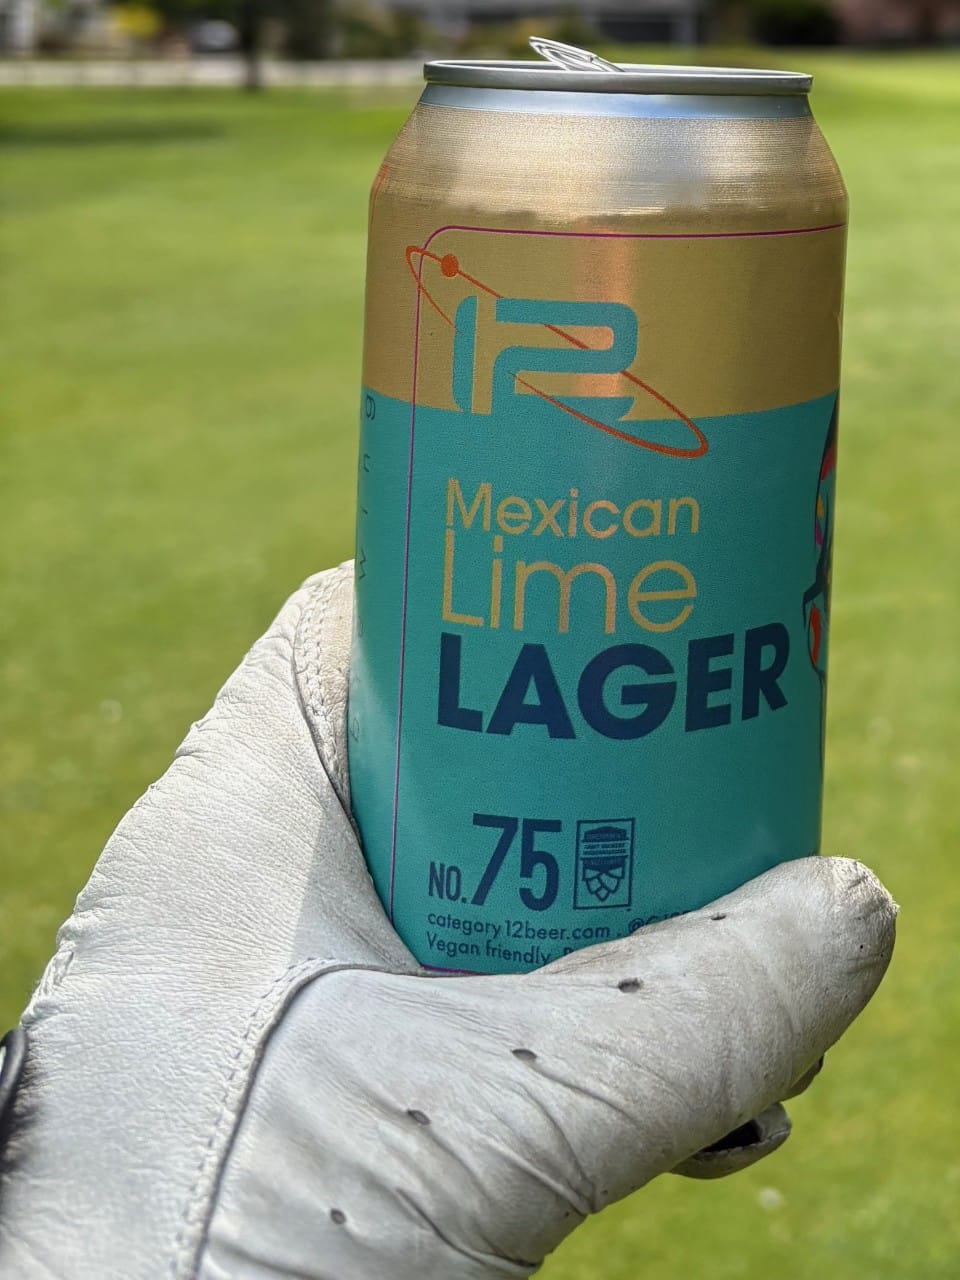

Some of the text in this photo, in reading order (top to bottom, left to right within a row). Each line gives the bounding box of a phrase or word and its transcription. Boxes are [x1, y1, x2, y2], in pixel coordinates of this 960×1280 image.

[446, 478, 700, 540] Mexican
[441, 528, 698, 634] Lime
[437, 622, 790, 741] LAGER
[426, 931, 482, 958] Vegan
[485, 939, 551, 965] friendly
[427, 911, 611, 941] category12beer.com
